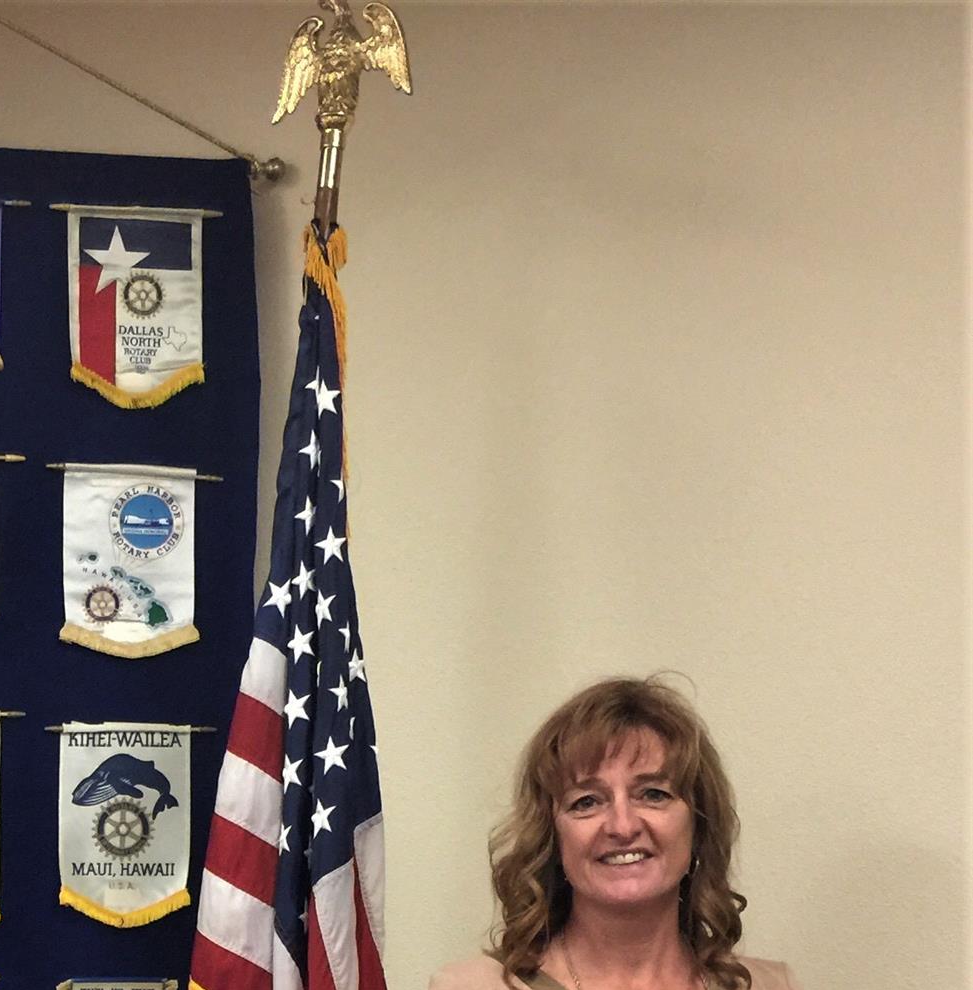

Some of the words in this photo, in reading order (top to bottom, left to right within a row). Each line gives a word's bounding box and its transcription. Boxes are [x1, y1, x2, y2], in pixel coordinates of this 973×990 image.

[118, 325, 164, 336] DALLAS
[121, 337, 161, 348] NORTH
[129, 356, 152, 365] CLUB
[112, 487, 139, 518] PEARL
[147, 485, 181, 519] HARBOR
[113, 530, 150, 559] ROTARY
[156, 532, 180, 556] CLUB
[68, 732, 182, 747] KIHEI-WAILEA
[72, 863, 116, 877] MAUI,
[121, 863, 176, 876] HAWAII
